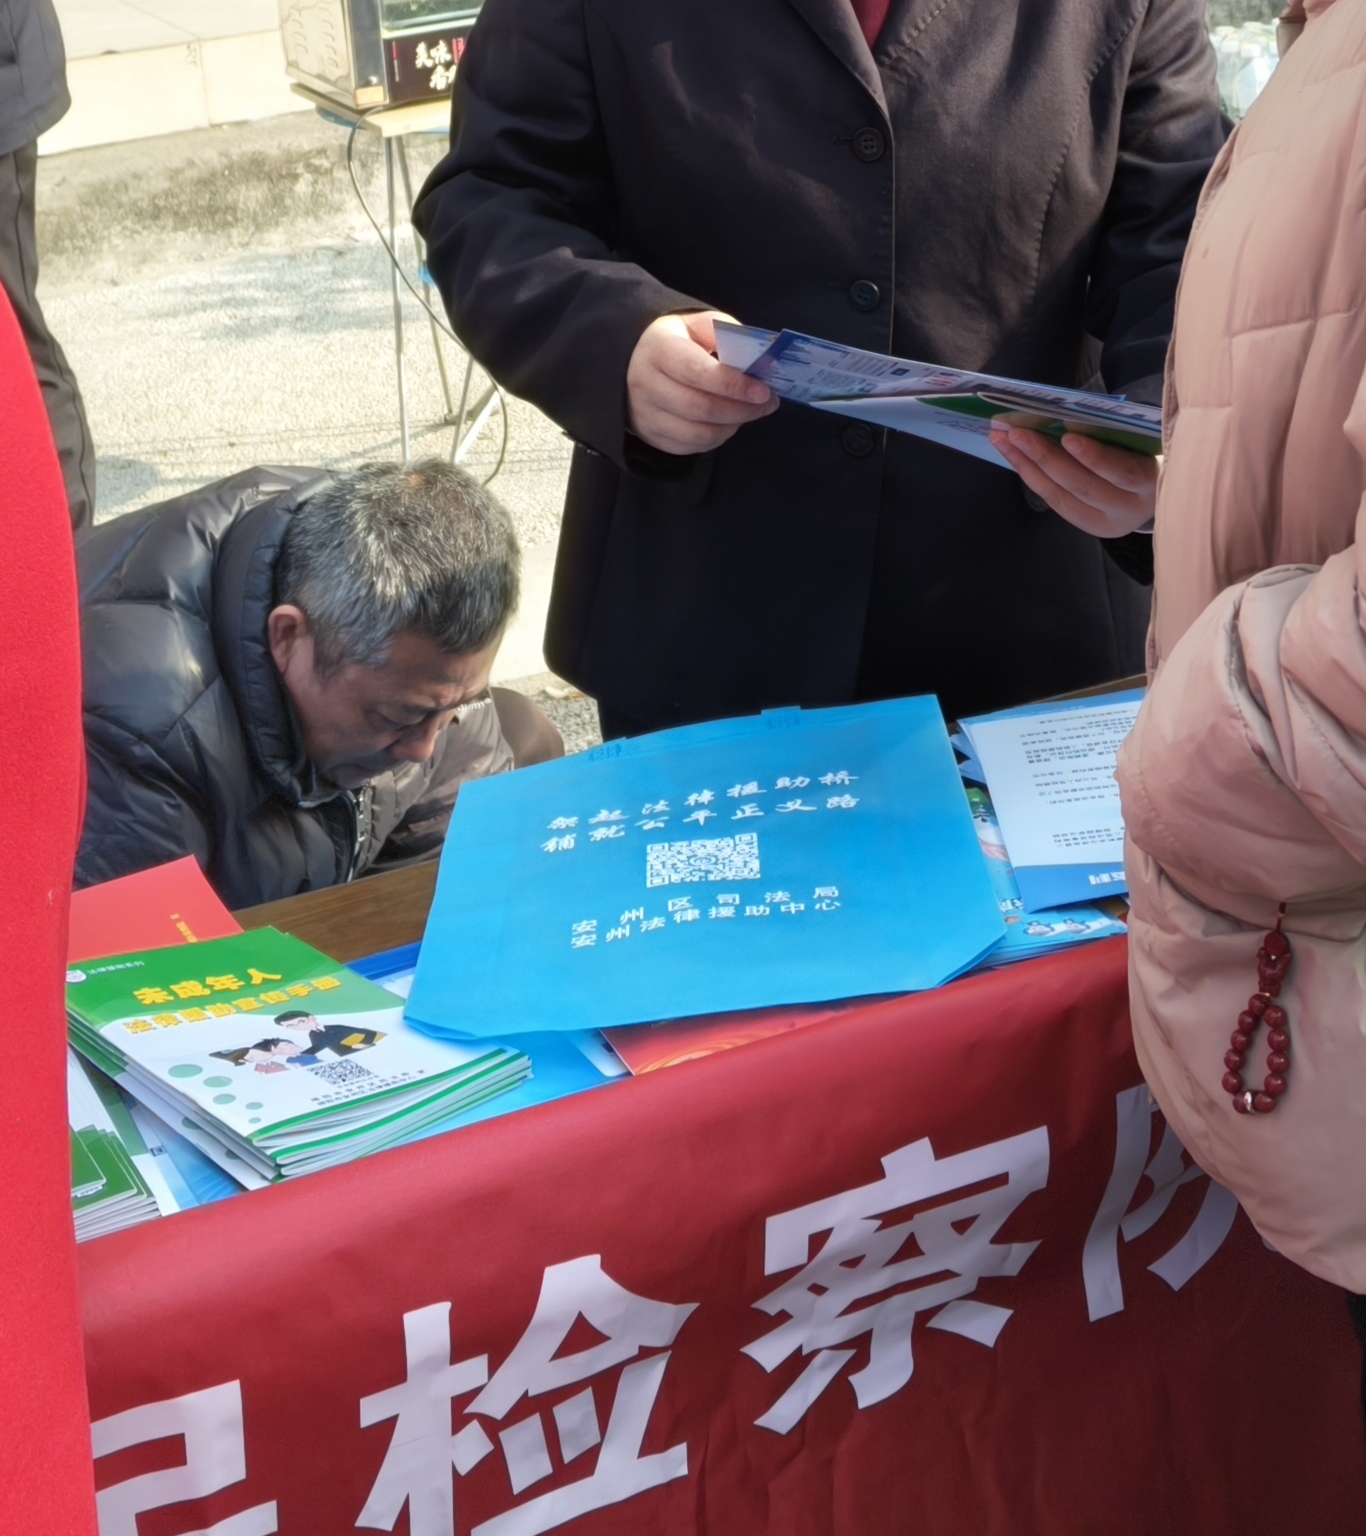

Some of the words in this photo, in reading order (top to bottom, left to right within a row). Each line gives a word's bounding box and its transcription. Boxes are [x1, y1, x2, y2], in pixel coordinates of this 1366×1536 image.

[540, 793, 861, 854] 铺就公平正义路
[570, 898, 842, 949] 安州法律援助中心
[571, 885, 839, 935] 安州区司法局
[132, 967, 282, 1006] 未成年人
